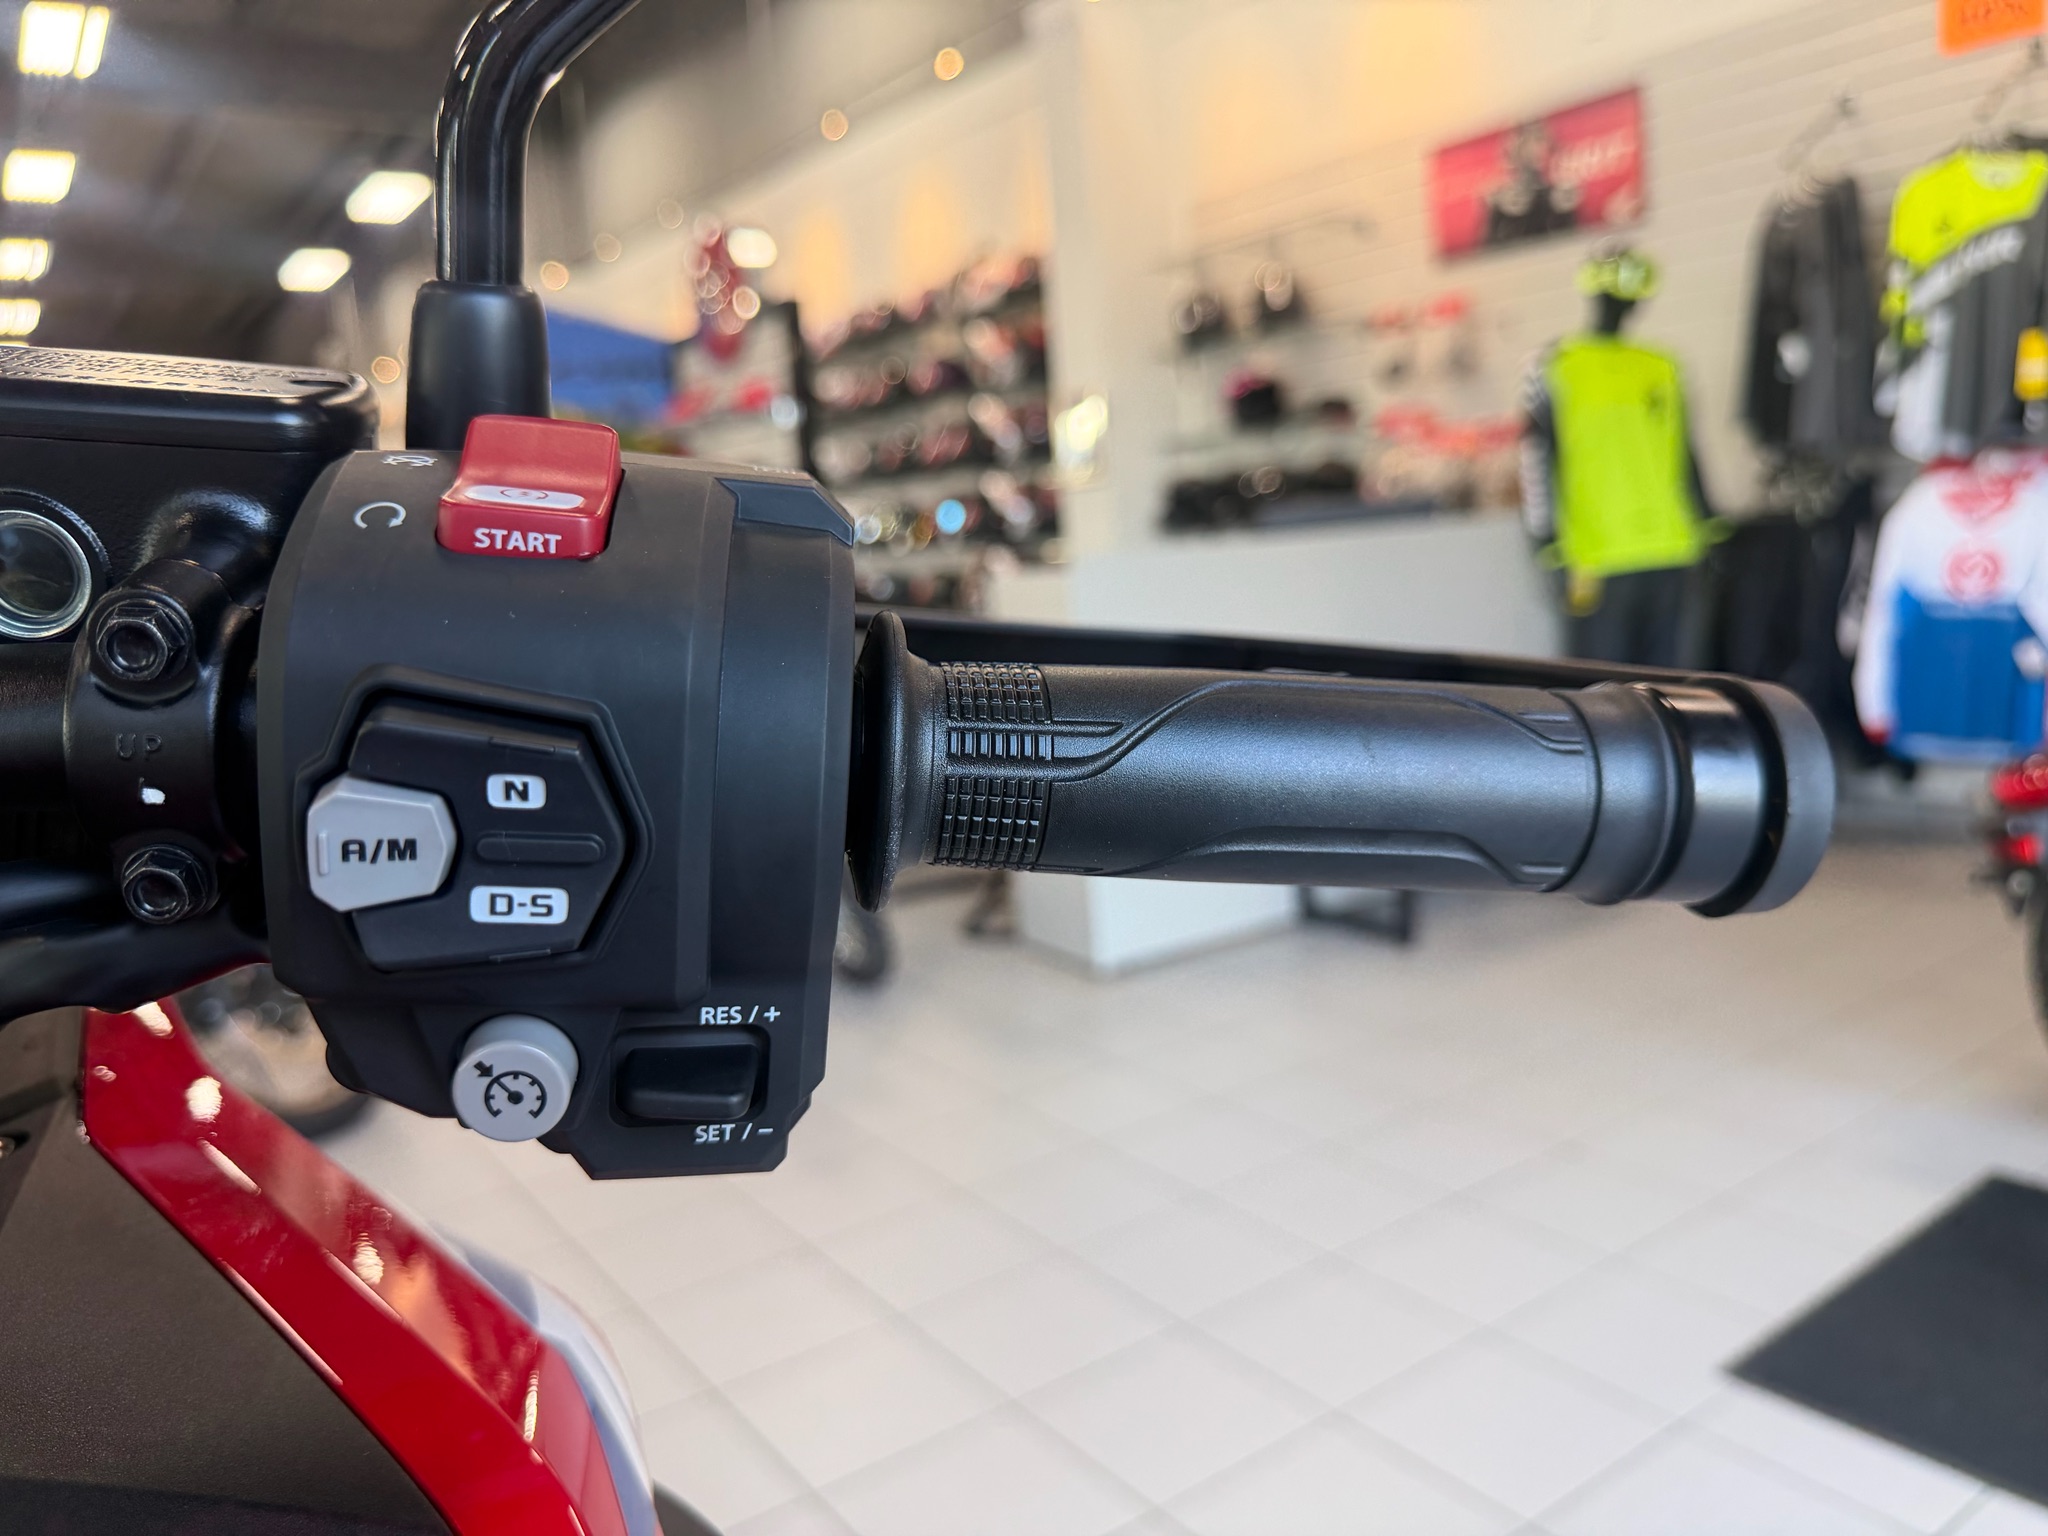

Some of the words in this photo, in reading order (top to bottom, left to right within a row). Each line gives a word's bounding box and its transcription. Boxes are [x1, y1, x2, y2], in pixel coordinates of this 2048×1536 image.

[474, 527, 562, 555] START
[115, 733, 163, 759] UP
[503, 780, 530, 803] N
[340, 837, 418, 865] A/M
[488, 892, 555, 918] D-S
[699, 1005, 743, 1025] RES
[693, 1123, 736, 1144] SET
